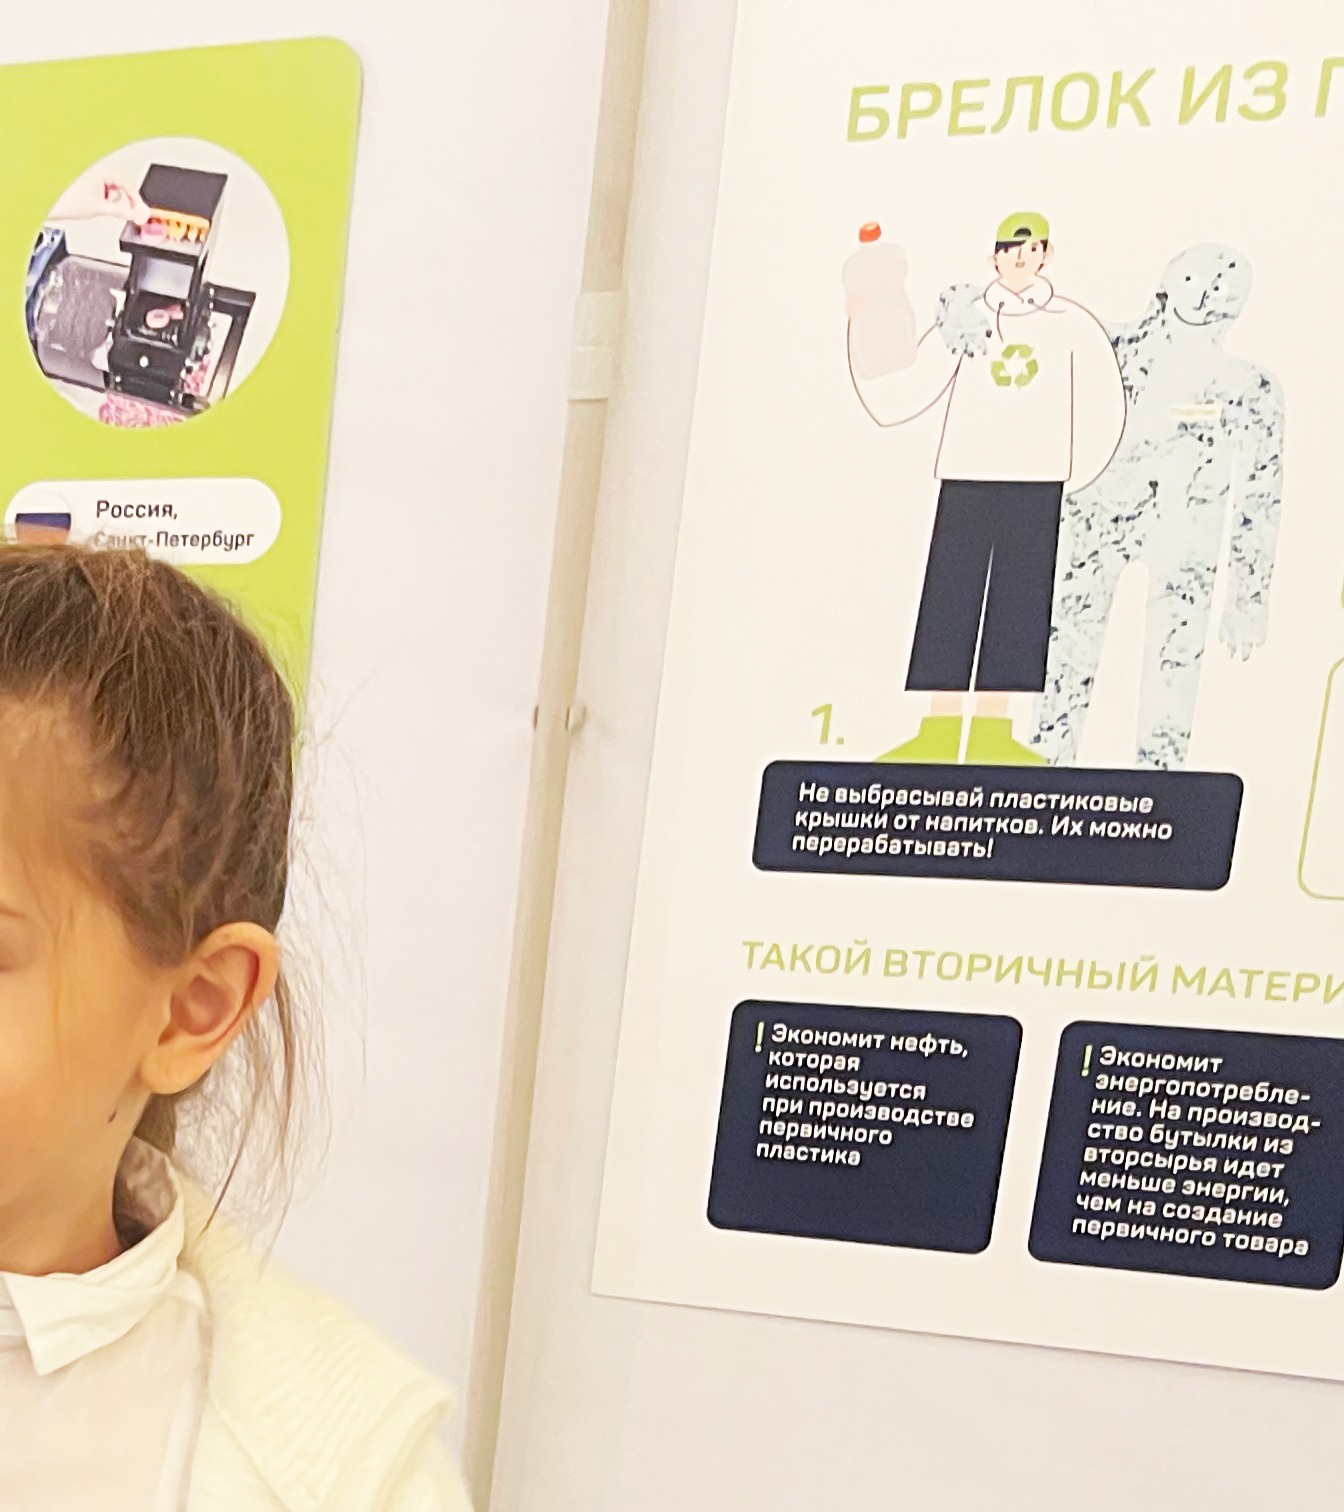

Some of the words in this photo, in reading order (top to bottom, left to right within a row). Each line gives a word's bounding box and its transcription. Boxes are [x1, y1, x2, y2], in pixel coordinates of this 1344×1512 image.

[846, 67, 1156, 142] БРЕЛОК
[1178, 60, 1288, 125] ИЗ
[96, 500, 177, 520] Россия,
[811, 703, 844, 745] 1.
[798, 782, 829, 803] Не
[834, 783, 983, 809] выбрасывай
[990, 791, 1153, 814] пластиковые
[795, 809, 887, 831] крышки
[893, 814, 919, 831] от
[925, 815, 1044, 835] напитков.
[1051, 815, 1083, 836] Их
[1089, 820, 1173, 841] можно
[792, 834, 994, 858] перерабатывать!
[742, 939, 872, 976] ТАКОЙ
[883, 949, 1158, 993] ВТОРИЧНЫЙ
[771, 1023, 885, 1049] Экономит
[890, 1033, 968, 1058] нефть,
[768, 1051, 861, 1074] которая
[1099, 1045, 1223, 1073] Экономит
[765, 1073, 927, 1101] используется
[1094, 1073, 1310, 1106] энергопотребле-
[762, 1097, 803, 1117] при
[808, 1101, 975, 1128] производстве
[1091, 1098, 1141, 1118] ние.
[1148, 1099, 1181, 1121] На
[1187, 1106, 1321, 1134] производ-
[759, 1119, 893, 1146] первичного
[1087, 1122, 1143, 1140] ство
[1149, 1123, 1258, 1152] бутылки
[1263, 1137, 1294, 1155] из
[756, 1142, 861, 1166] пластика
[1083, 1146, 1217, 1174] вторсырья
[1222, 1158, 1285, 1179] идет
[1079, 1169, 1176, 1194] меньше
[1181, 1179, 1289, 1207] энергии,
[1076, 1193, 1121, 1213] чем
[1126, 1199, 1156, 1216] на
[1162, 1202, 1283, 1228] создание
[1072, 1217, 1217, 1247] первичного
[1222, 1232, 1310, 1258] товара
